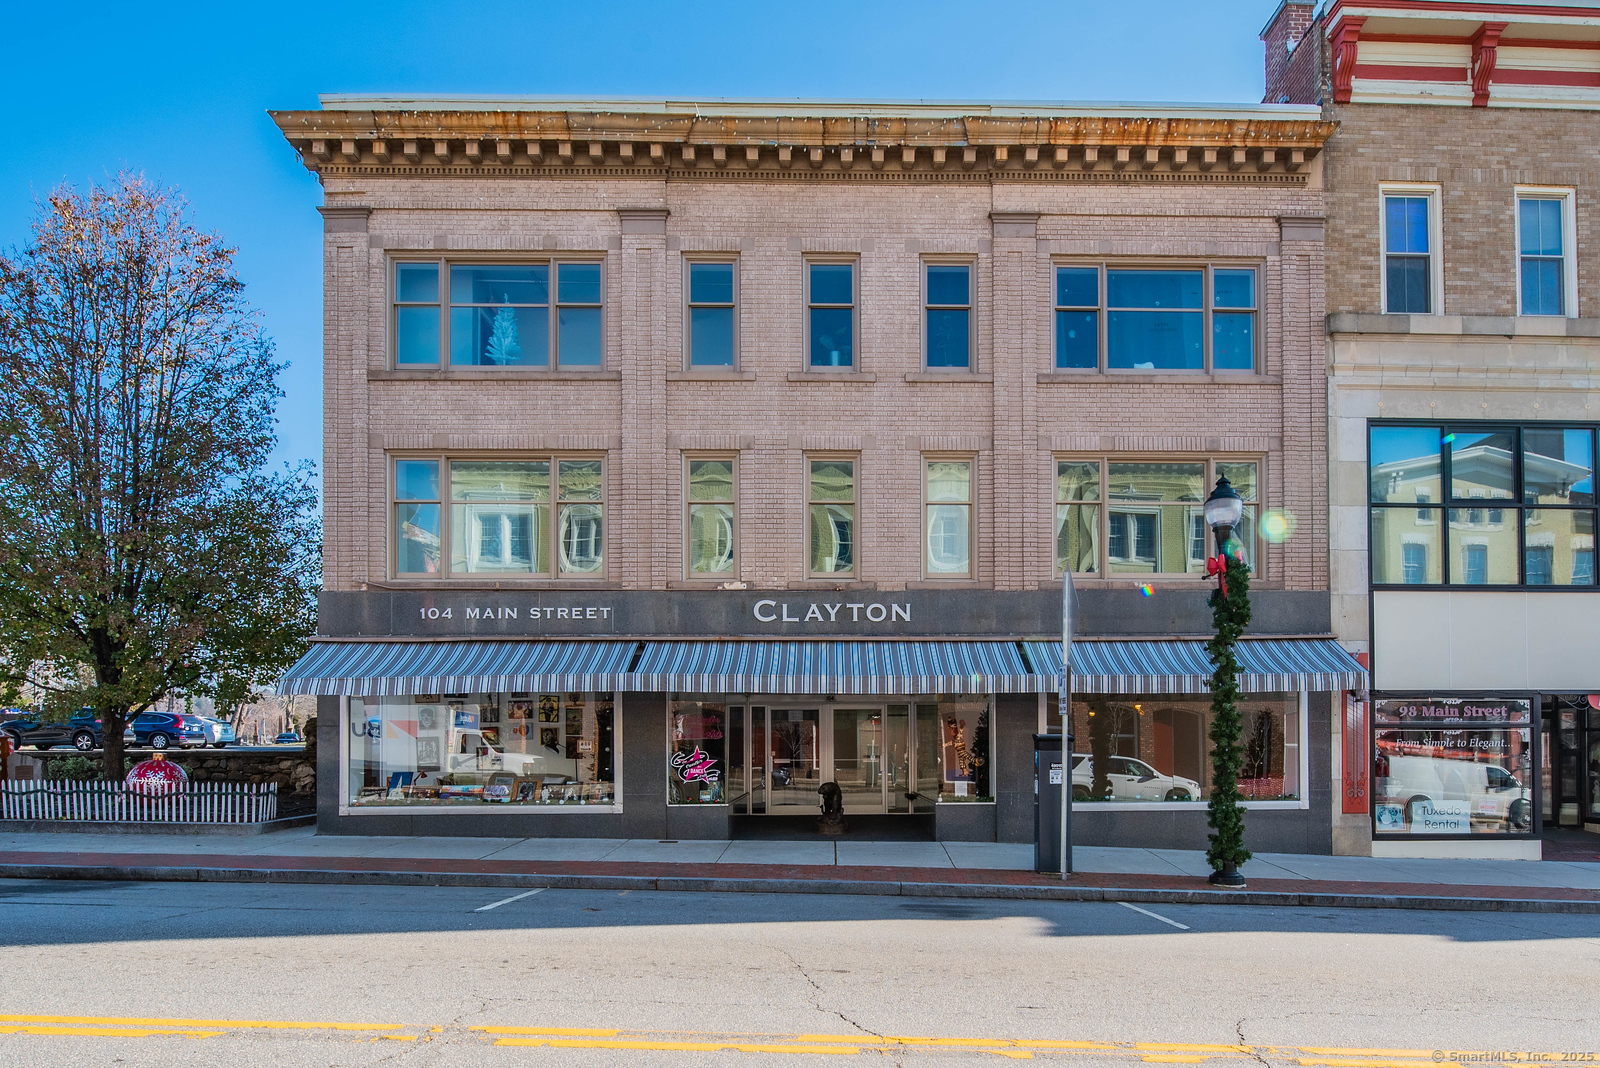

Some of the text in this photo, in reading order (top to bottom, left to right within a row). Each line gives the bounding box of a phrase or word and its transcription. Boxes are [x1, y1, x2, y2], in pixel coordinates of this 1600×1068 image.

[419, 607, 612, 620] 104 MAIN STREET
[752, 600, 912, 623] CLAYTON
[1399, 705, 1508, 717] 98 Main Street
[1396, 738, 1513, 749] From Simple to Elegant...
[1421, 805, 1461, 816] Tuxedo
[1424, 819, 1460, 829] Rental
